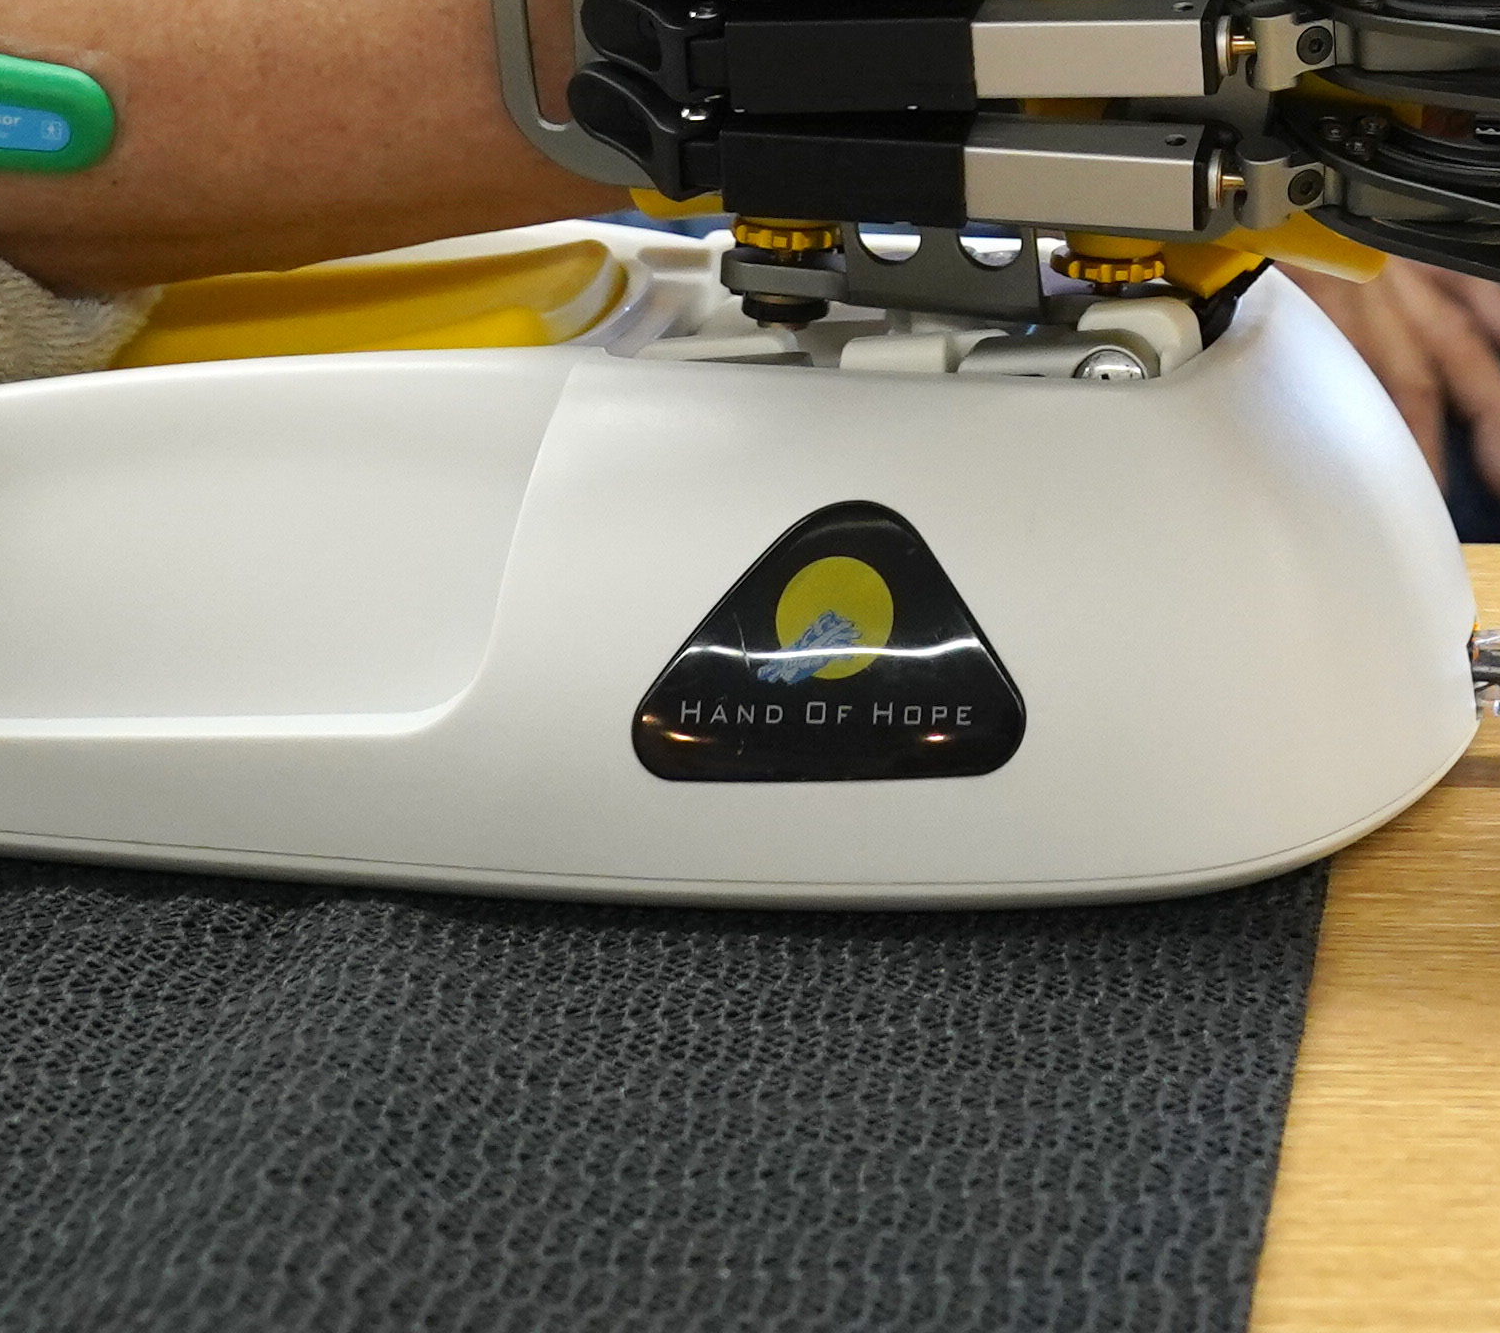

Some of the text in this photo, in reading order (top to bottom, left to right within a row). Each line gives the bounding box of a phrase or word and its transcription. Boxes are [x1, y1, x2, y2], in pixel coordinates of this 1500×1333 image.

[679, 700, 973, 726] HAND OF HOPE
